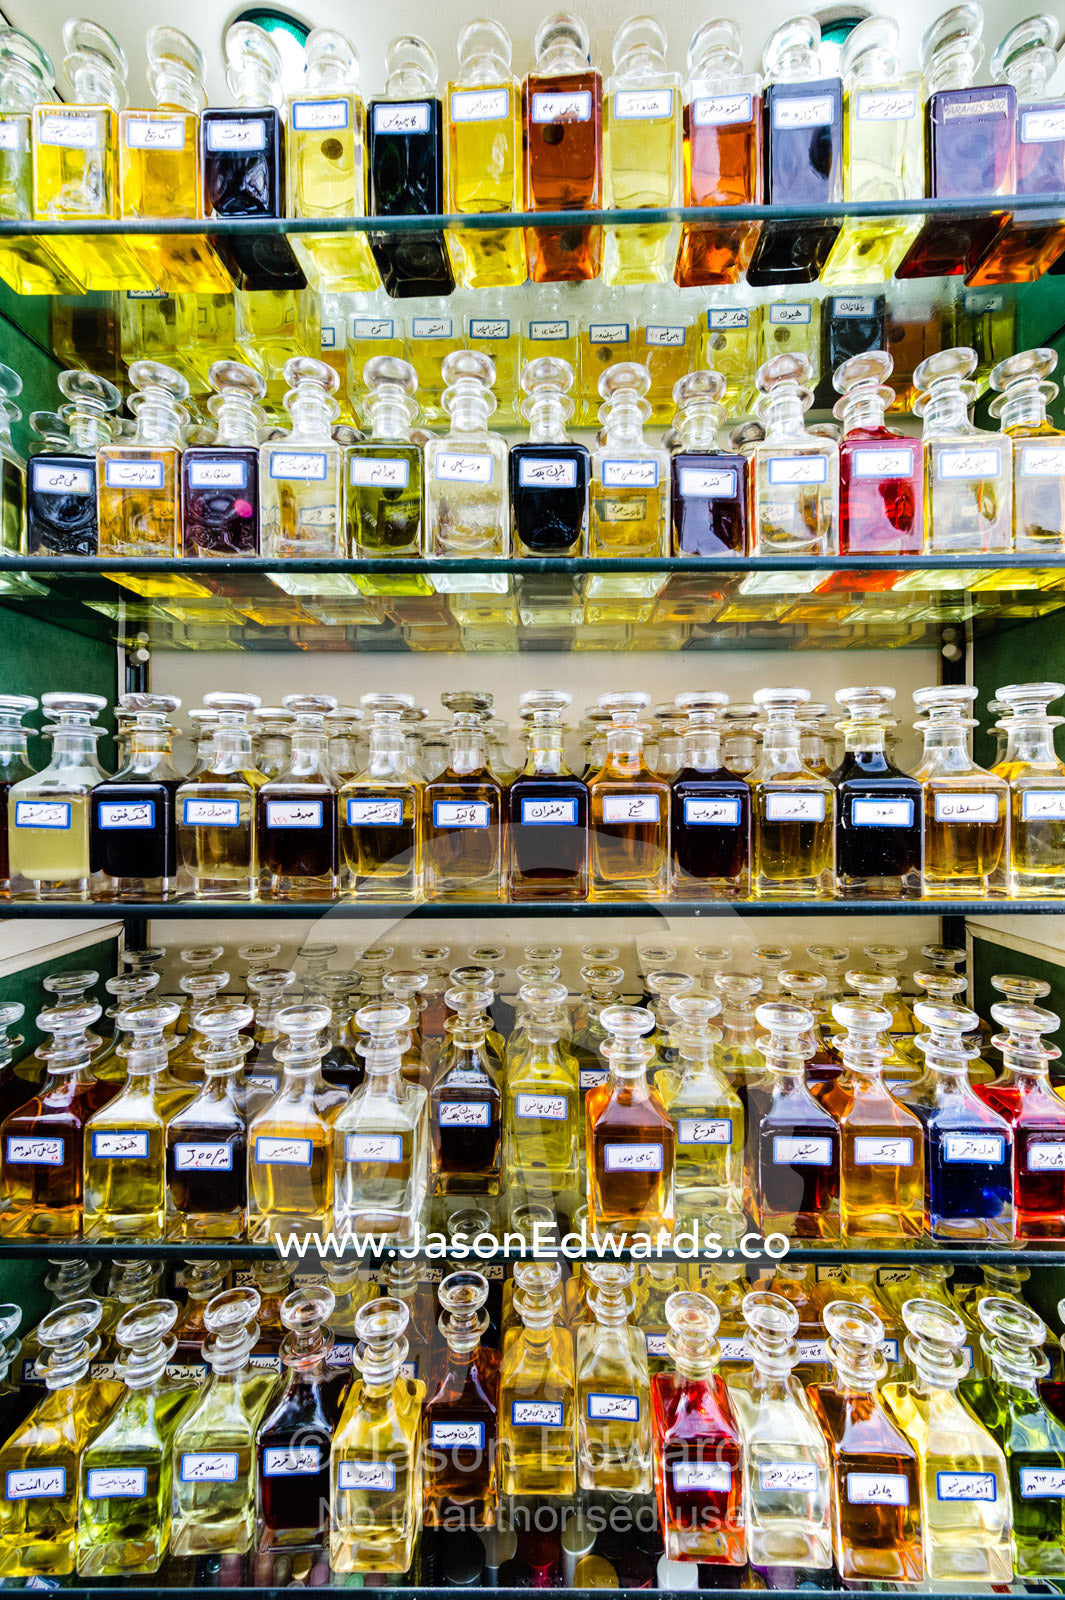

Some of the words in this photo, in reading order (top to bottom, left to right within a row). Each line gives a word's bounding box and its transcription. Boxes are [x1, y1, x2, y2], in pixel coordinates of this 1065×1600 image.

[987, 98, 1007, 111] 900
[531, 804, 566, 819] زعفران
[941, 802, 985, 816] سلطان
